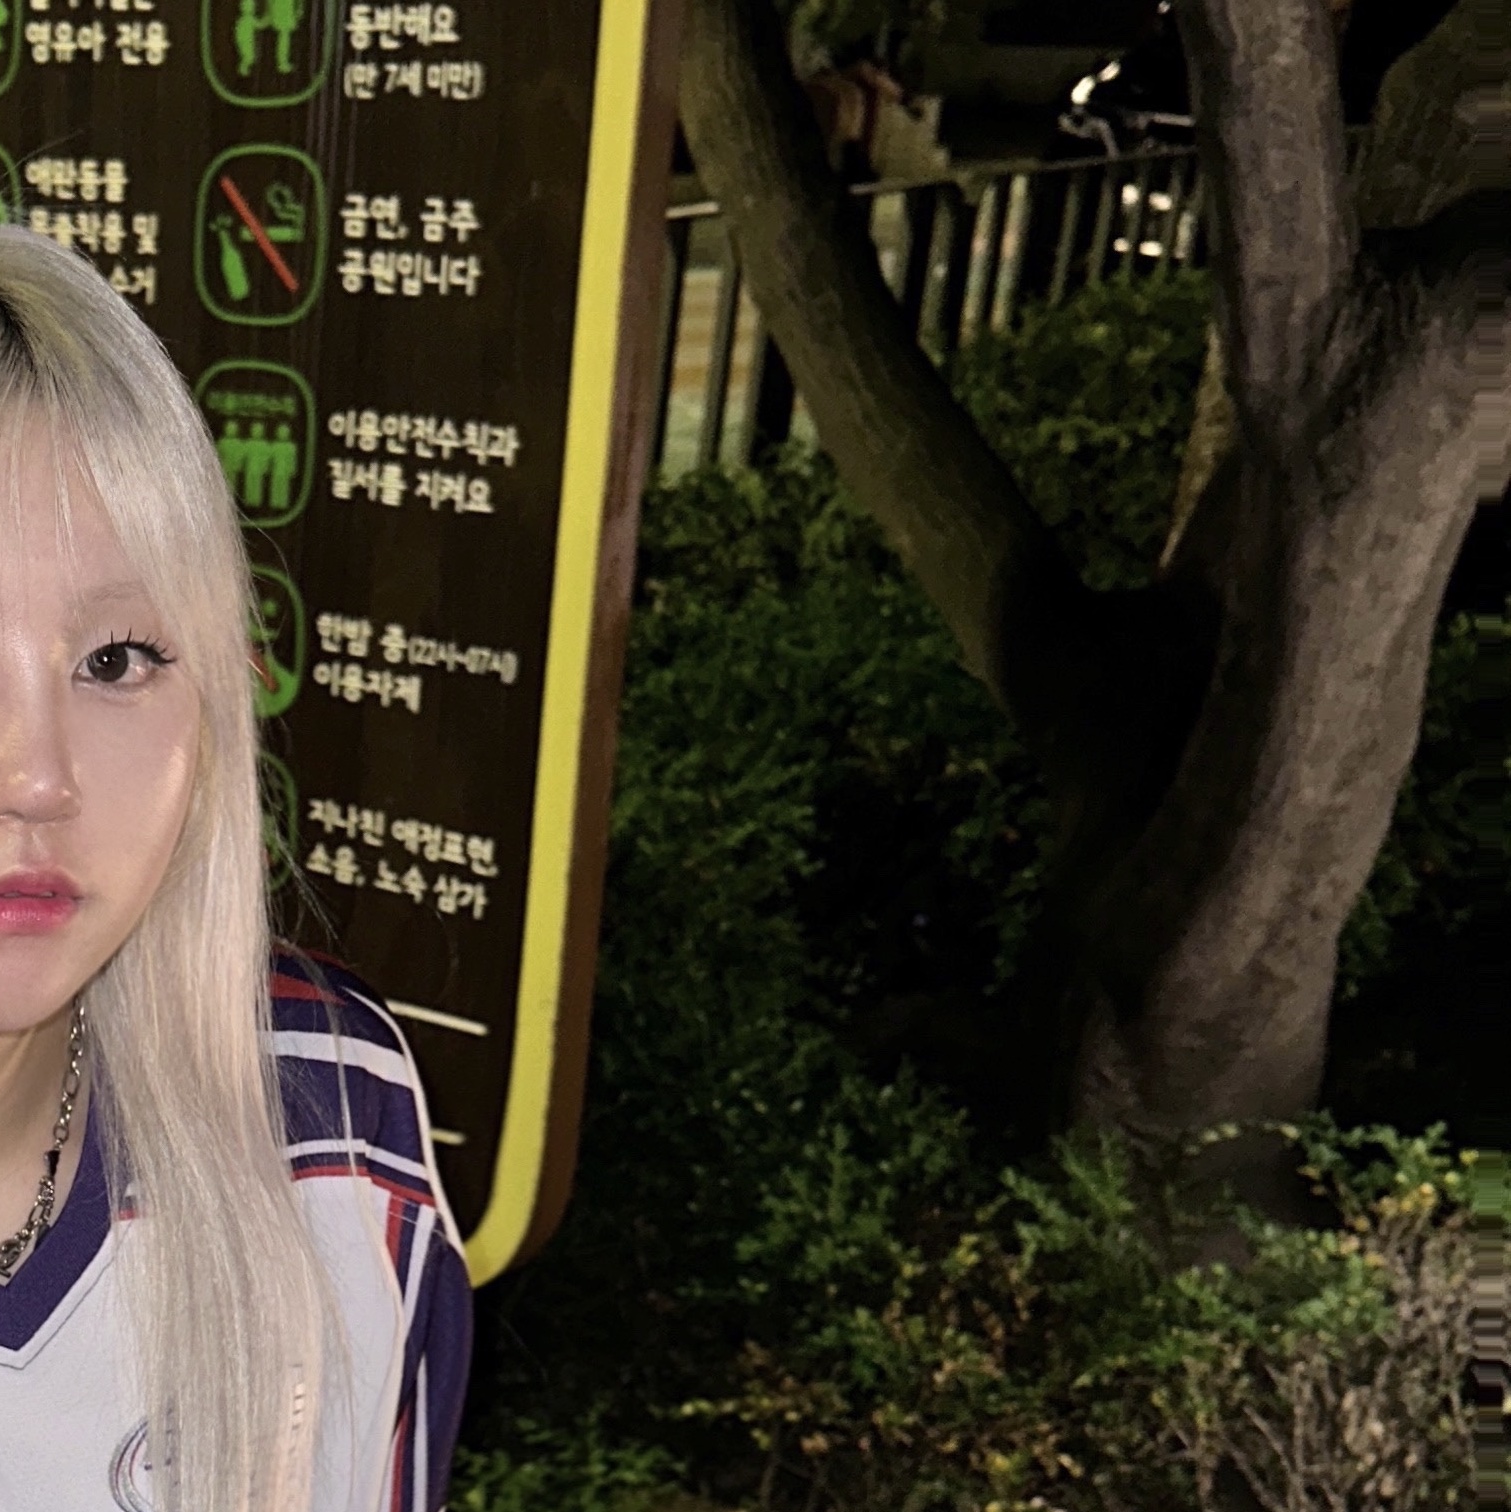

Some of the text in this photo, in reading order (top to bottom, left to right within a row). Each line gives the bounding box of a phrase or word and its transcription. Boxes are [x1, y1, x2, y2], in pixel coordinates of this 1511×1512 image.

[25, 20, 171, 65] 영유아 전용
[384, 60, 422, 98] 7세
[25, 157, 129, 203] 애완동물
[132, 211, 159, 255] 및
[419, 195, 480, 243] 금주
[337, 248, 481, 297] 공원입니다
[327, 409, 520, 467] 이용안전수칙과
[328, 457, 495, 514] 질서를 지켜요
[316, 612, 373, 657] 한밤
[312, 662, 422, 715] 이용자제
[308, 797, 386, 847] 지나친
[373, 857, 428, 904] 노숙
[433, 872, 488, 921] 삼가
